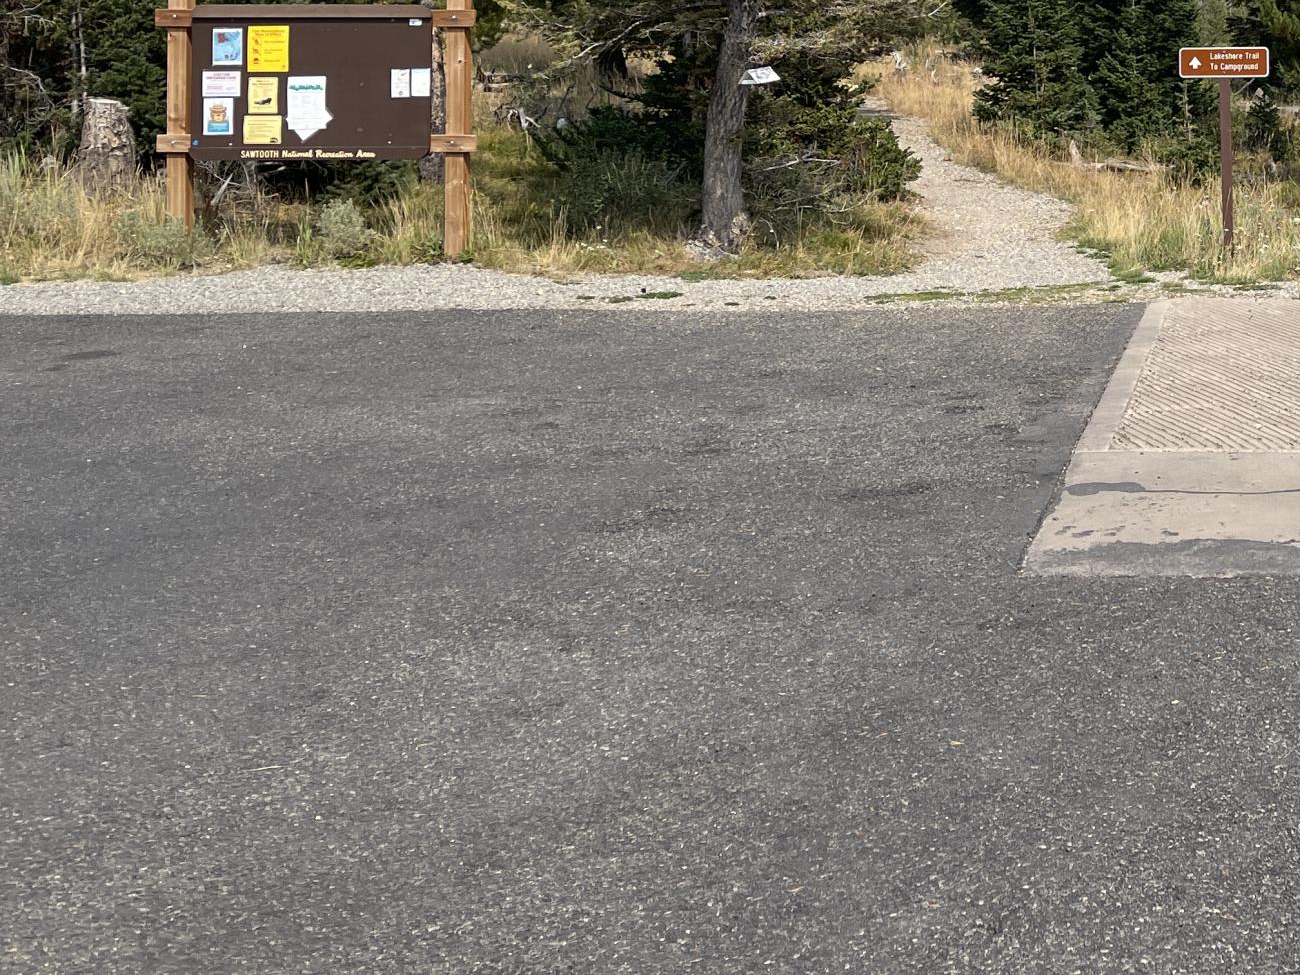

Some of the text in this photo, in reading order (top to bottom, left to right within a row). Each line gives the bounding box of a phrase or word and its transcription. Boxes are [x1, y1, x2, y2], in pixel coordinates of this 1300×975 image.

[1210, 52, 1243, 60] Lakeshore
[1210, 62, 1259, 72] To Campground
[240, 149, 376, 158] SAWTOOTH National Recreation Area
